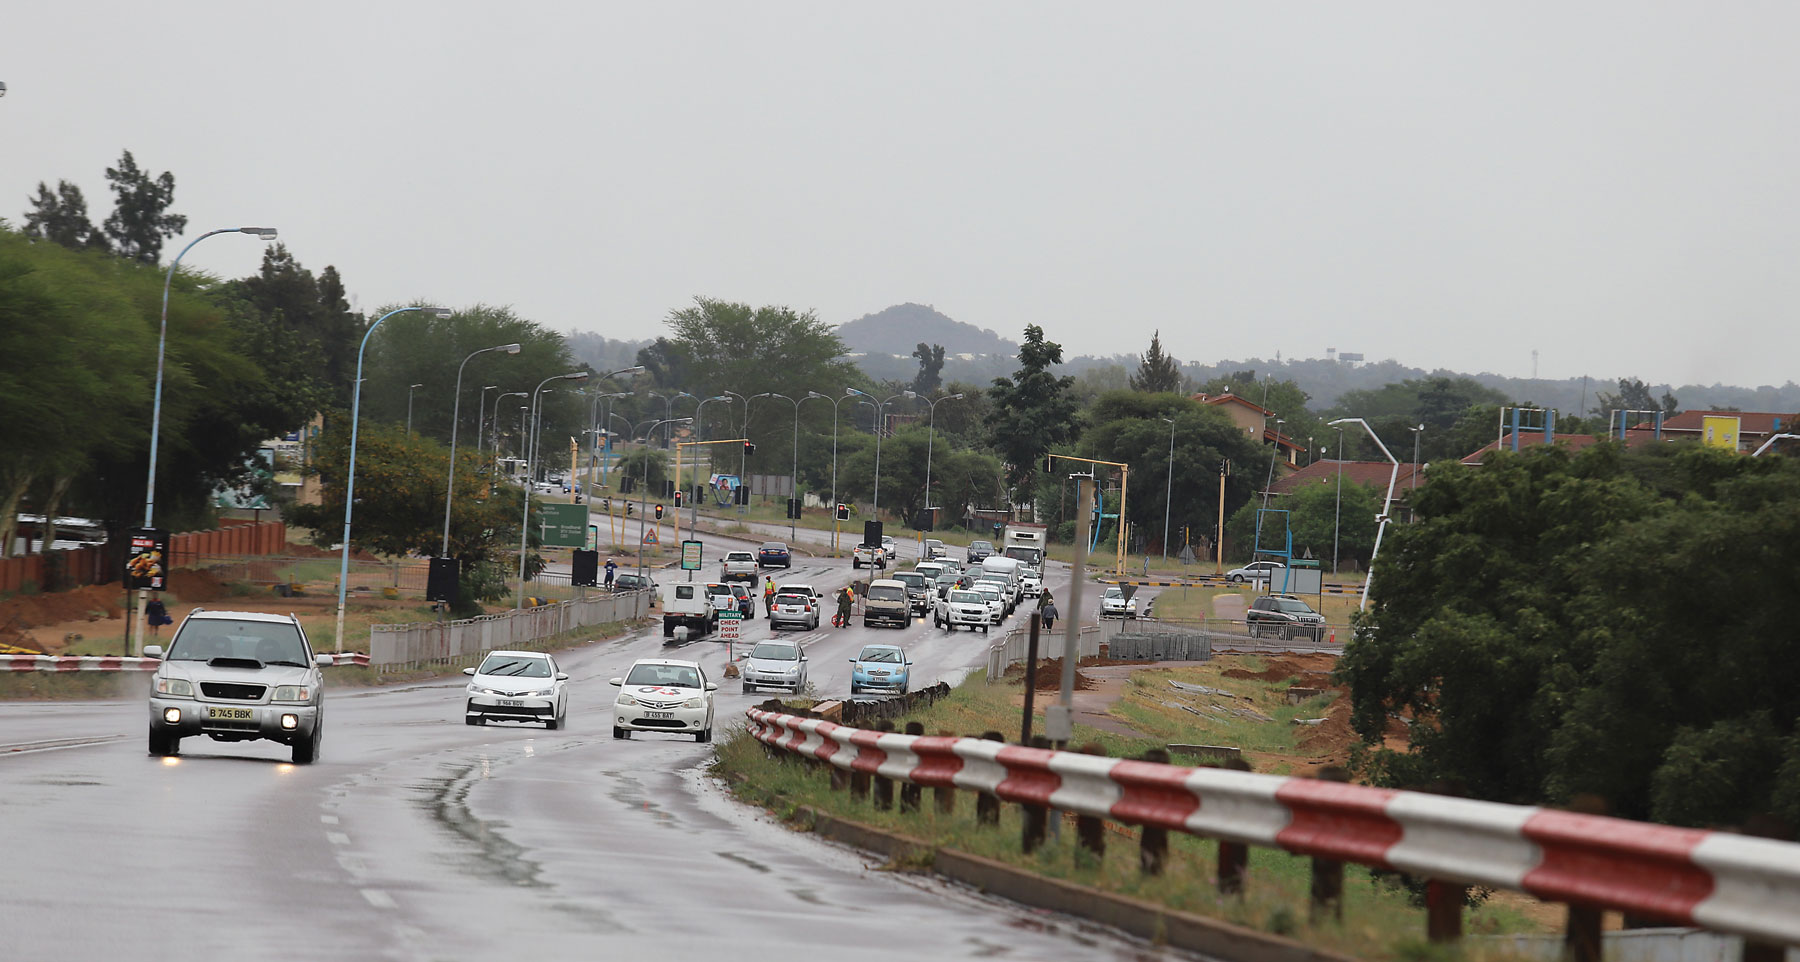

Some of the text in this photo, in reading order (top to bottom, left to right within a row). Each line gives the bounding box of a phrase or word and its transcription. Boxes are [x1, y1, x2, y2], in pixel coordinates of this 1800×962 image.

[210, 708, 251, 719] B 745 BBK
